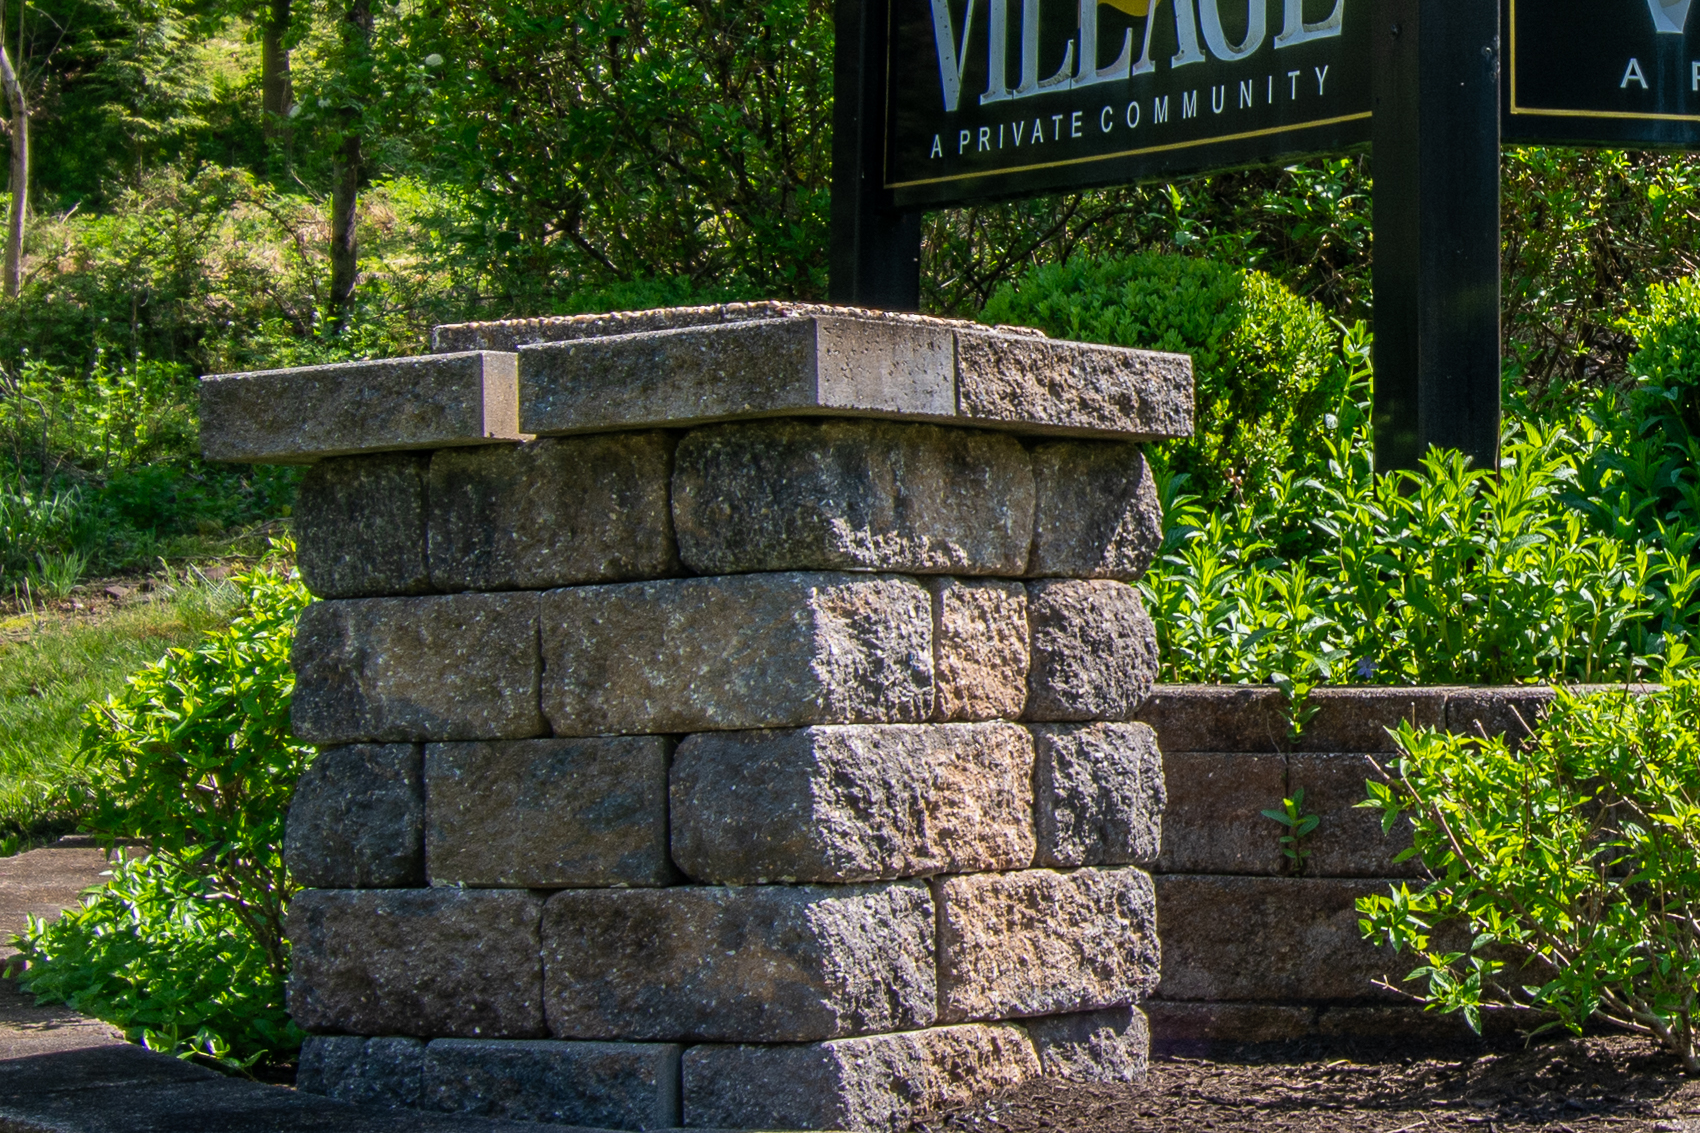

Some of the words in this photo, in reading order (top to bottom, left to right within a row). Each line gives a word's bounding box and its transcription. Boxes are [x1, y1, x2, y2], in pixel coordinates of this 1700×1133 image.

[1621, 59, 1648, 88] A
[930, 134, 943, 158] A
[959, 112, 1083, 154] PRIVATE
[1101, 65, 1329, 132] COMMUNITY
